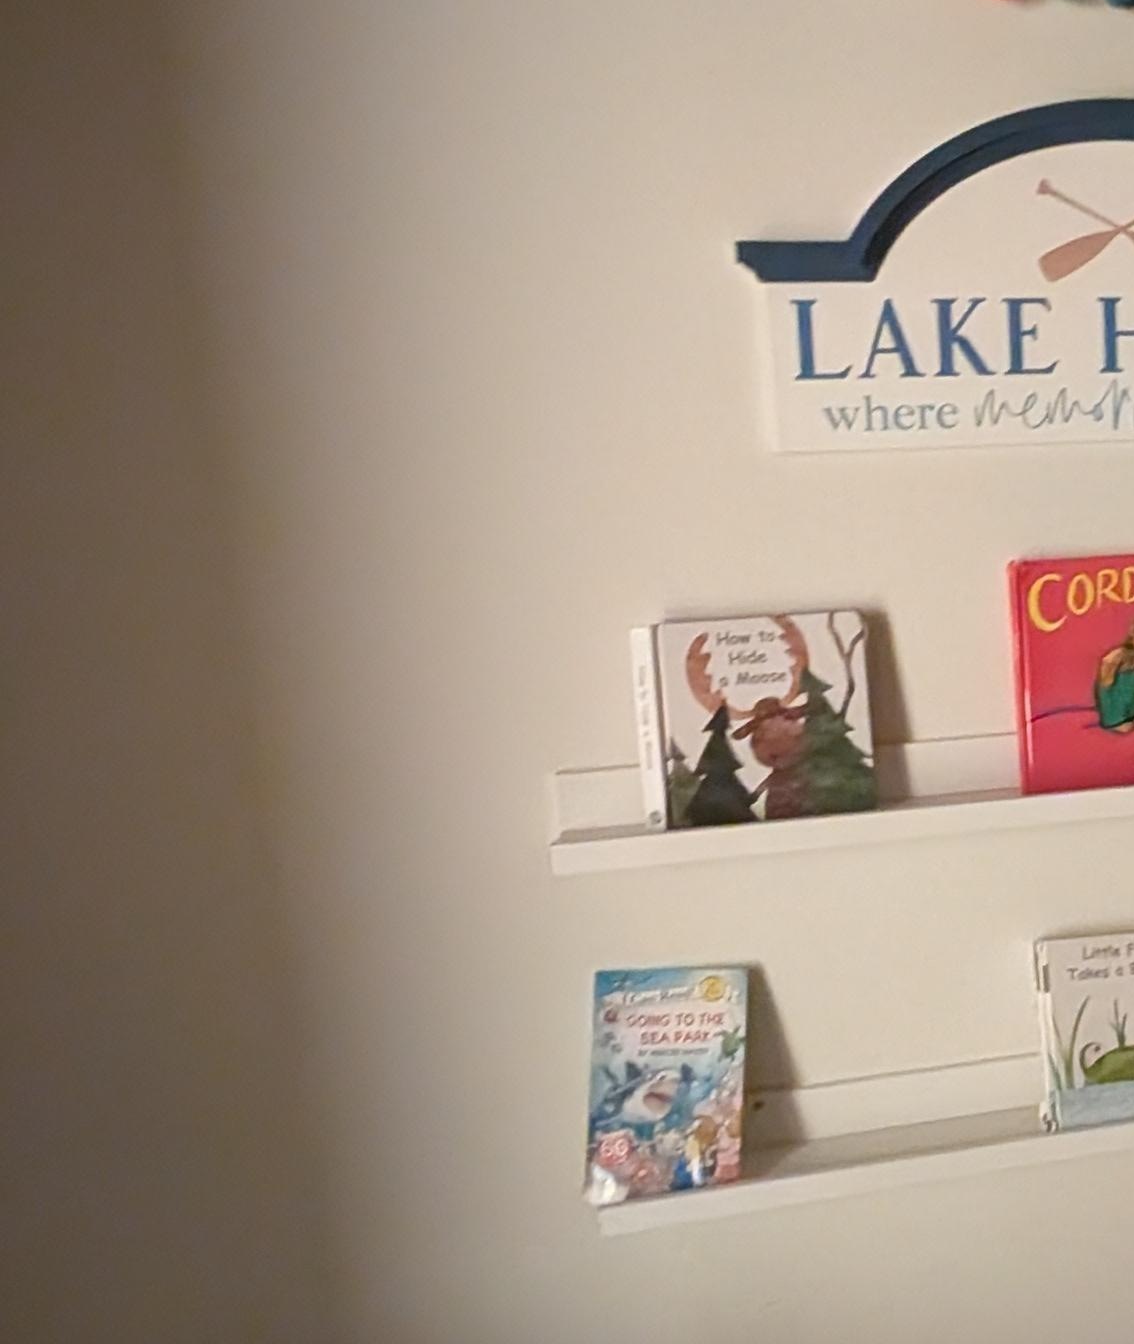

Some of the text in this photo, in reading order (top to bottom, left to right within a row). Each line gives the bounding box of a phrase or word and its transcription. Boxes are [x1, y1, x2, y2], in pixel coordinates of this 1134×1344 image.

[791, 297, 1059, 380] LAKE
[823, 395, 958, 432] where
[716, 631, 751, 646] How
[727, 650, 768, 666] Hide
[719, 671, 788, 688] a Moose
[1082, 944, 1121, 960] Little
[1066, 966, 1110, 981] Takes
[1114, 966, 1124, 977] a
[626, 1011, 727, 1028] GOING TO THE
[640, 1029, 711, 1045] SEA PARK
